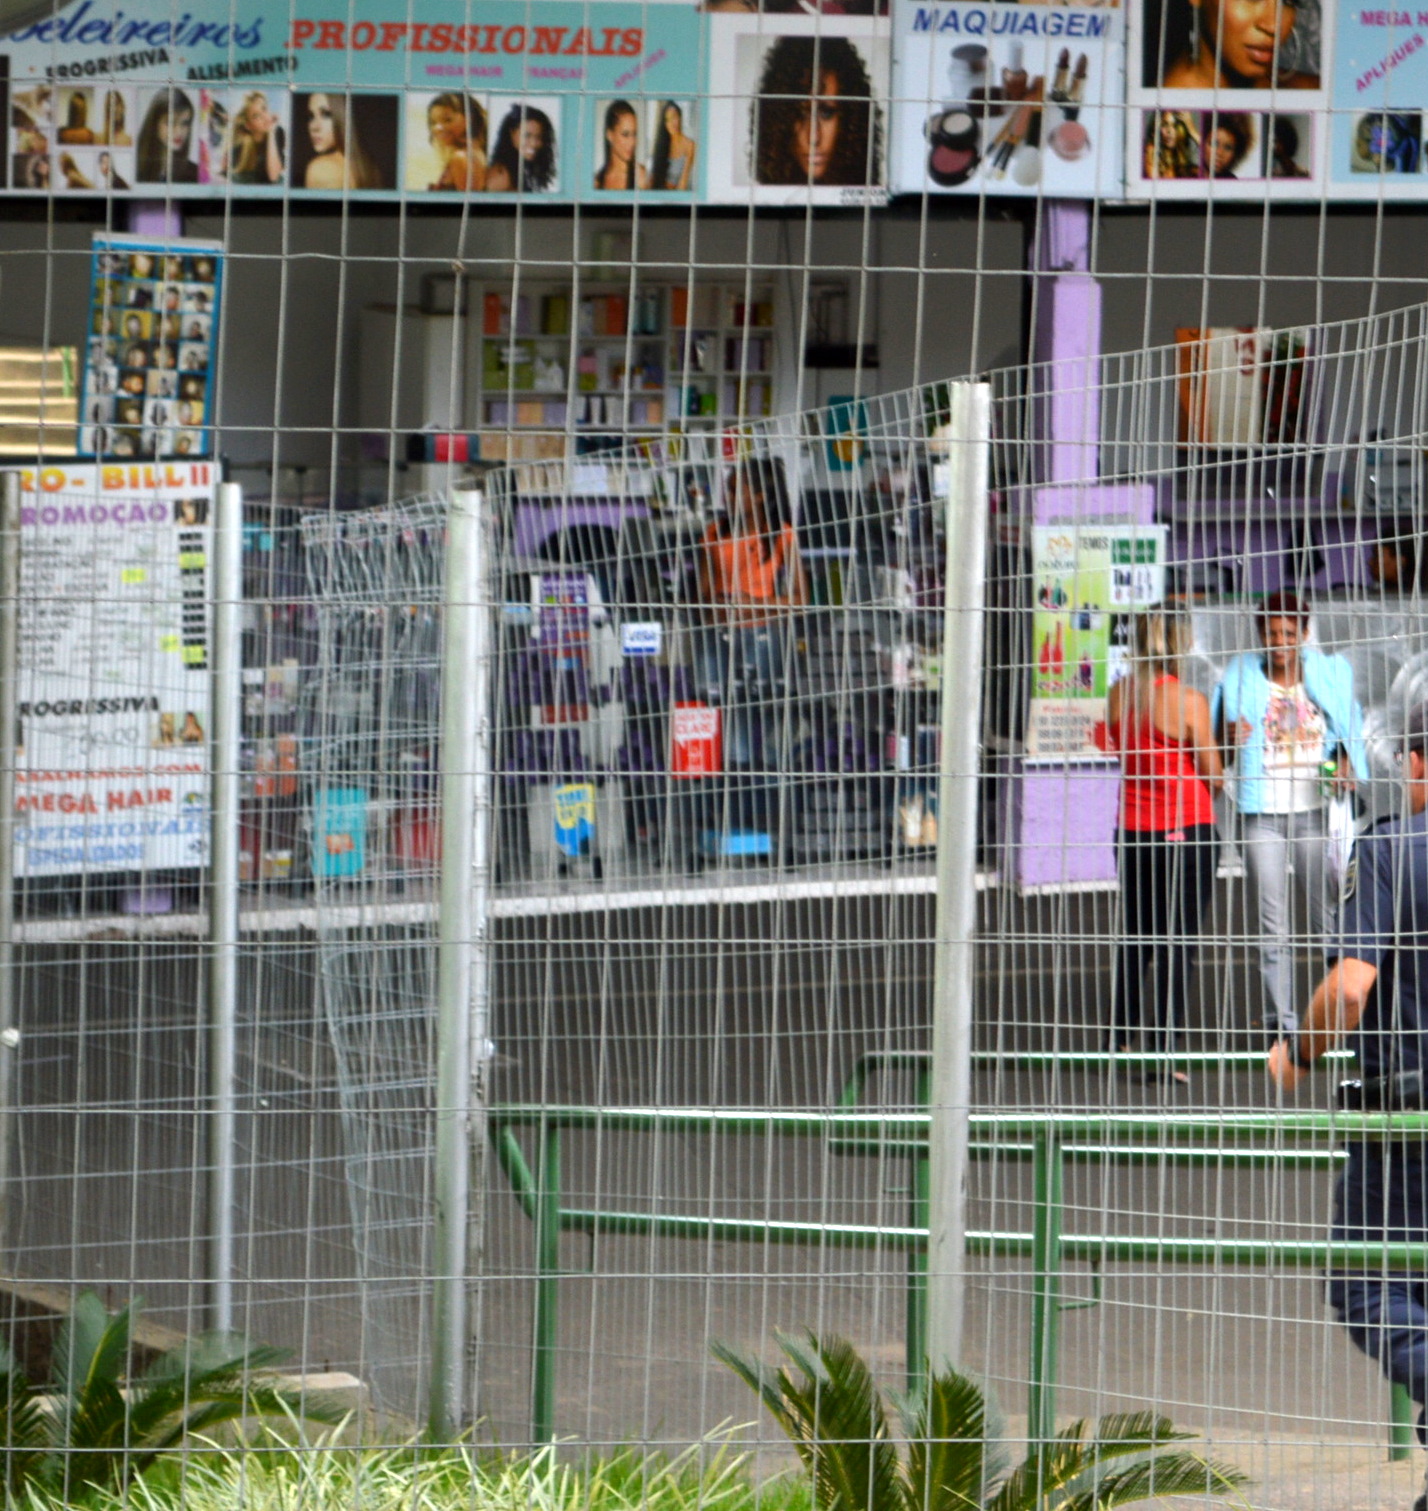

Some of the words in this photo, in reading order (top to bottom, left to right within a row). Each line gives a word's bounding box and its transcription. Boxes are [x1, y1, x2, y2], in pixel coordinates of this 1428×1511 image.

[913, 8, 1110, 37] MAQUIAGEM
[1360, 10, 1412, 27] MEGA
[284, 20, 643, 56] PROFISSIONAIS
[187, 56, 298, 80] ALISAMENTO
[1355, 34, 1424, 92] APLIQUES
[21, 466, 67, 492] RO
[102, 465, 184, 490] BILL
[19, 696, 160, 717] ROGRESSIVA
[16, 791, 97, 814] MEGA
[108, 788, 172, 812] HAIR
